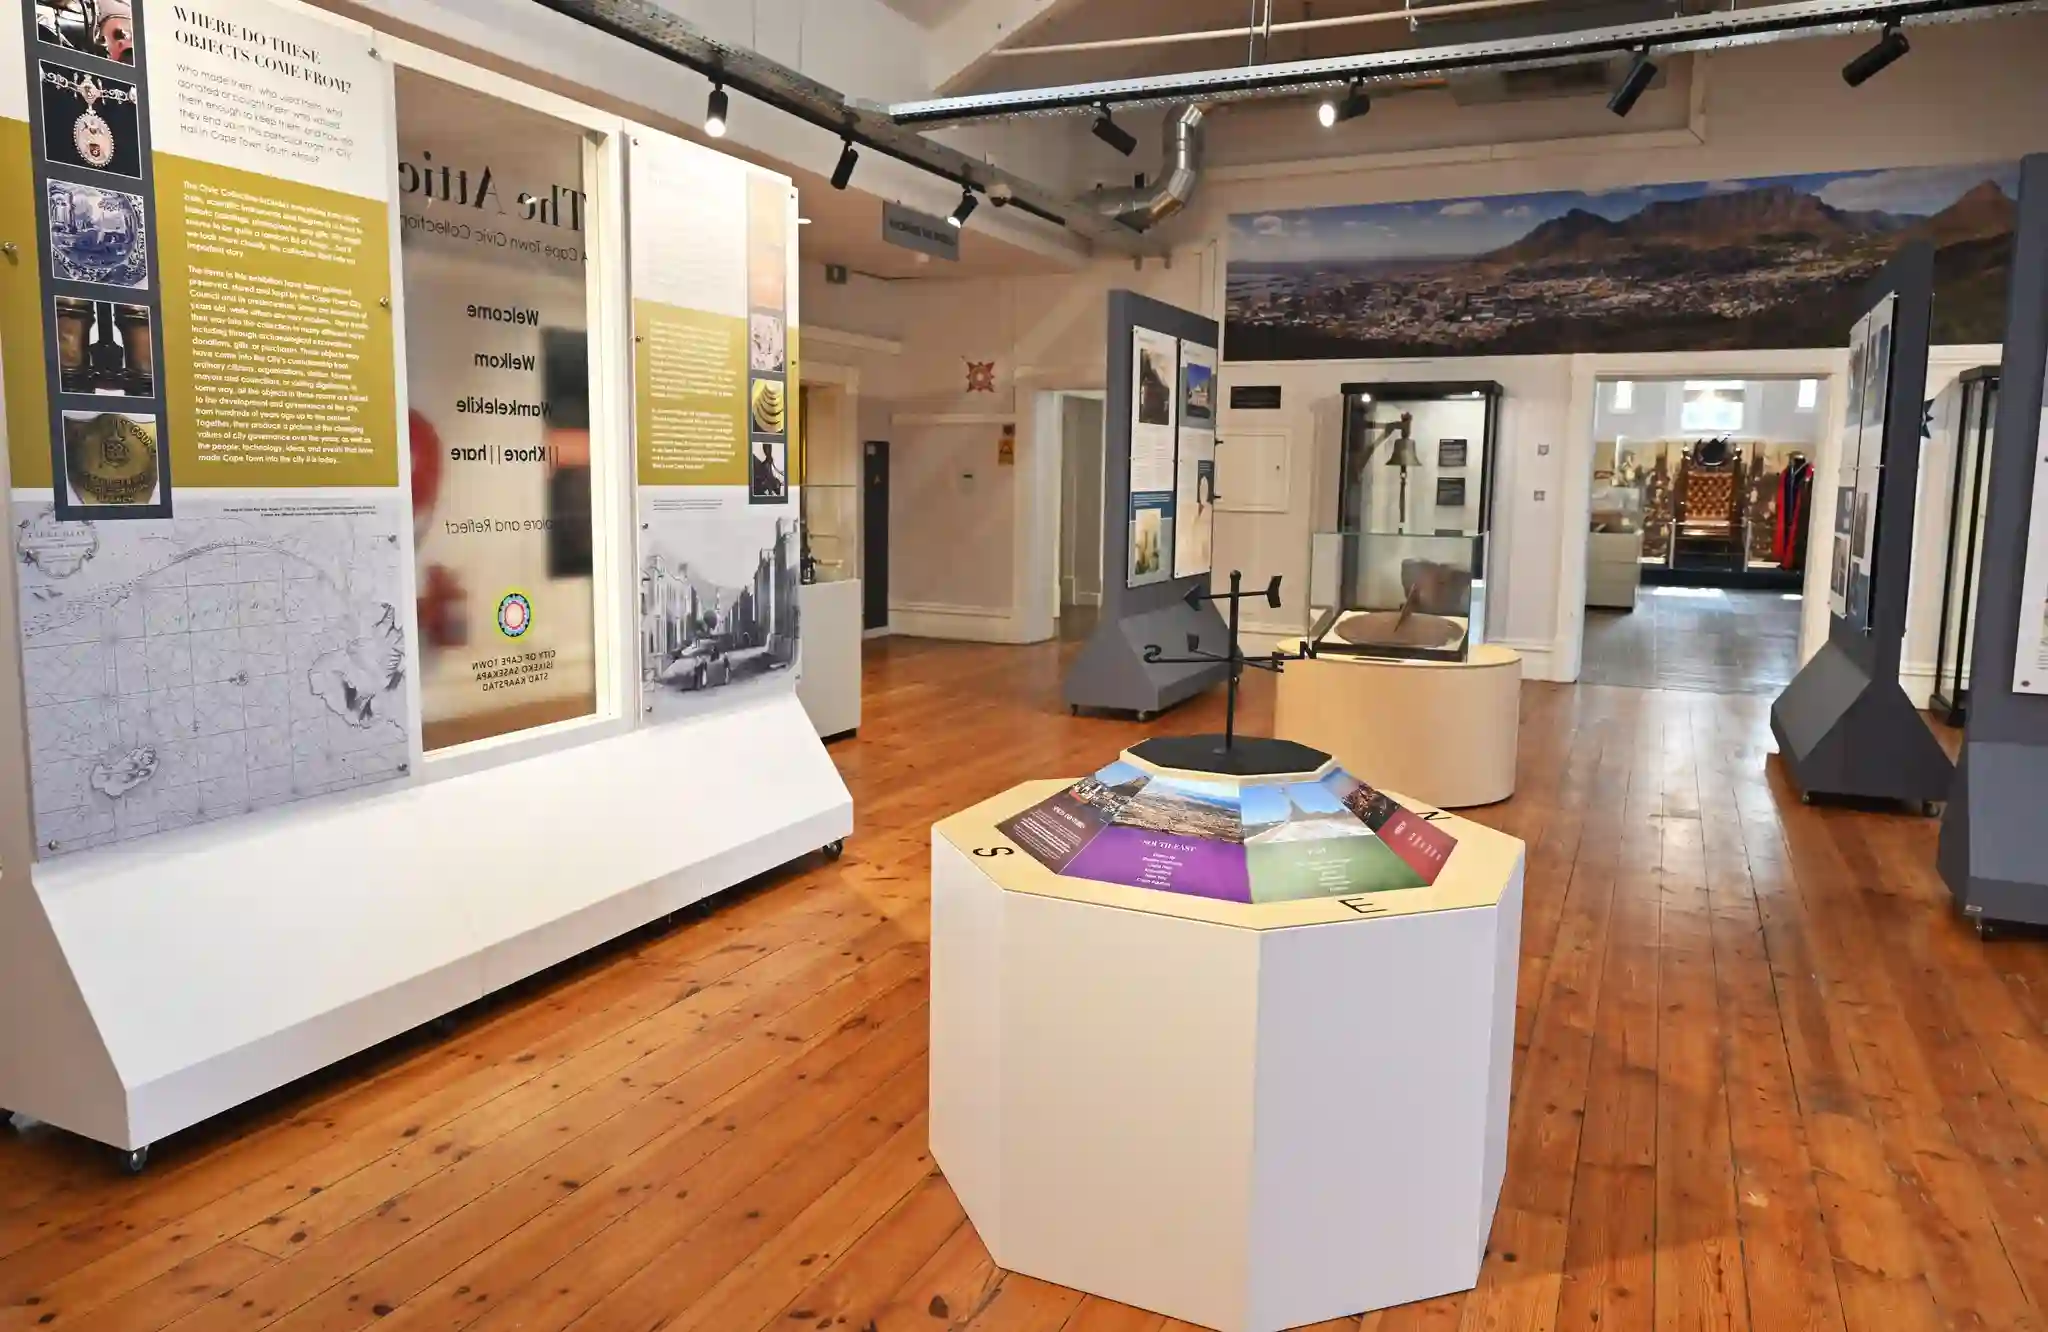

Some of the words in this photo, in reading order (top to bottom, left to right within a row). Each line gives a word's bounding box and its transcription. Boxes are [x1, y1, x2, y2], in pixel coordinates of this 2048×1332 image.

[174, 5, 237, 38] WHERE
[242, 27, 265, 47] DO
[269, 36, 320, 64] THESE
[175, 29, 249, 63] OBJECTS
[254, 53, 299, 79] COME
[304, 68, 351, 94] FROM?
[177, 63, 198, 76] Who
[201, 72, 228, 85] made
[179, 109, 200, 123] they
[203, 116, 220, 126] end
[211, 130, 236, 144] Cape
[1143, 644, 1162, 663] S
[973, 846, 1014, 857] S
[1338, 897, 1388, 914] E
